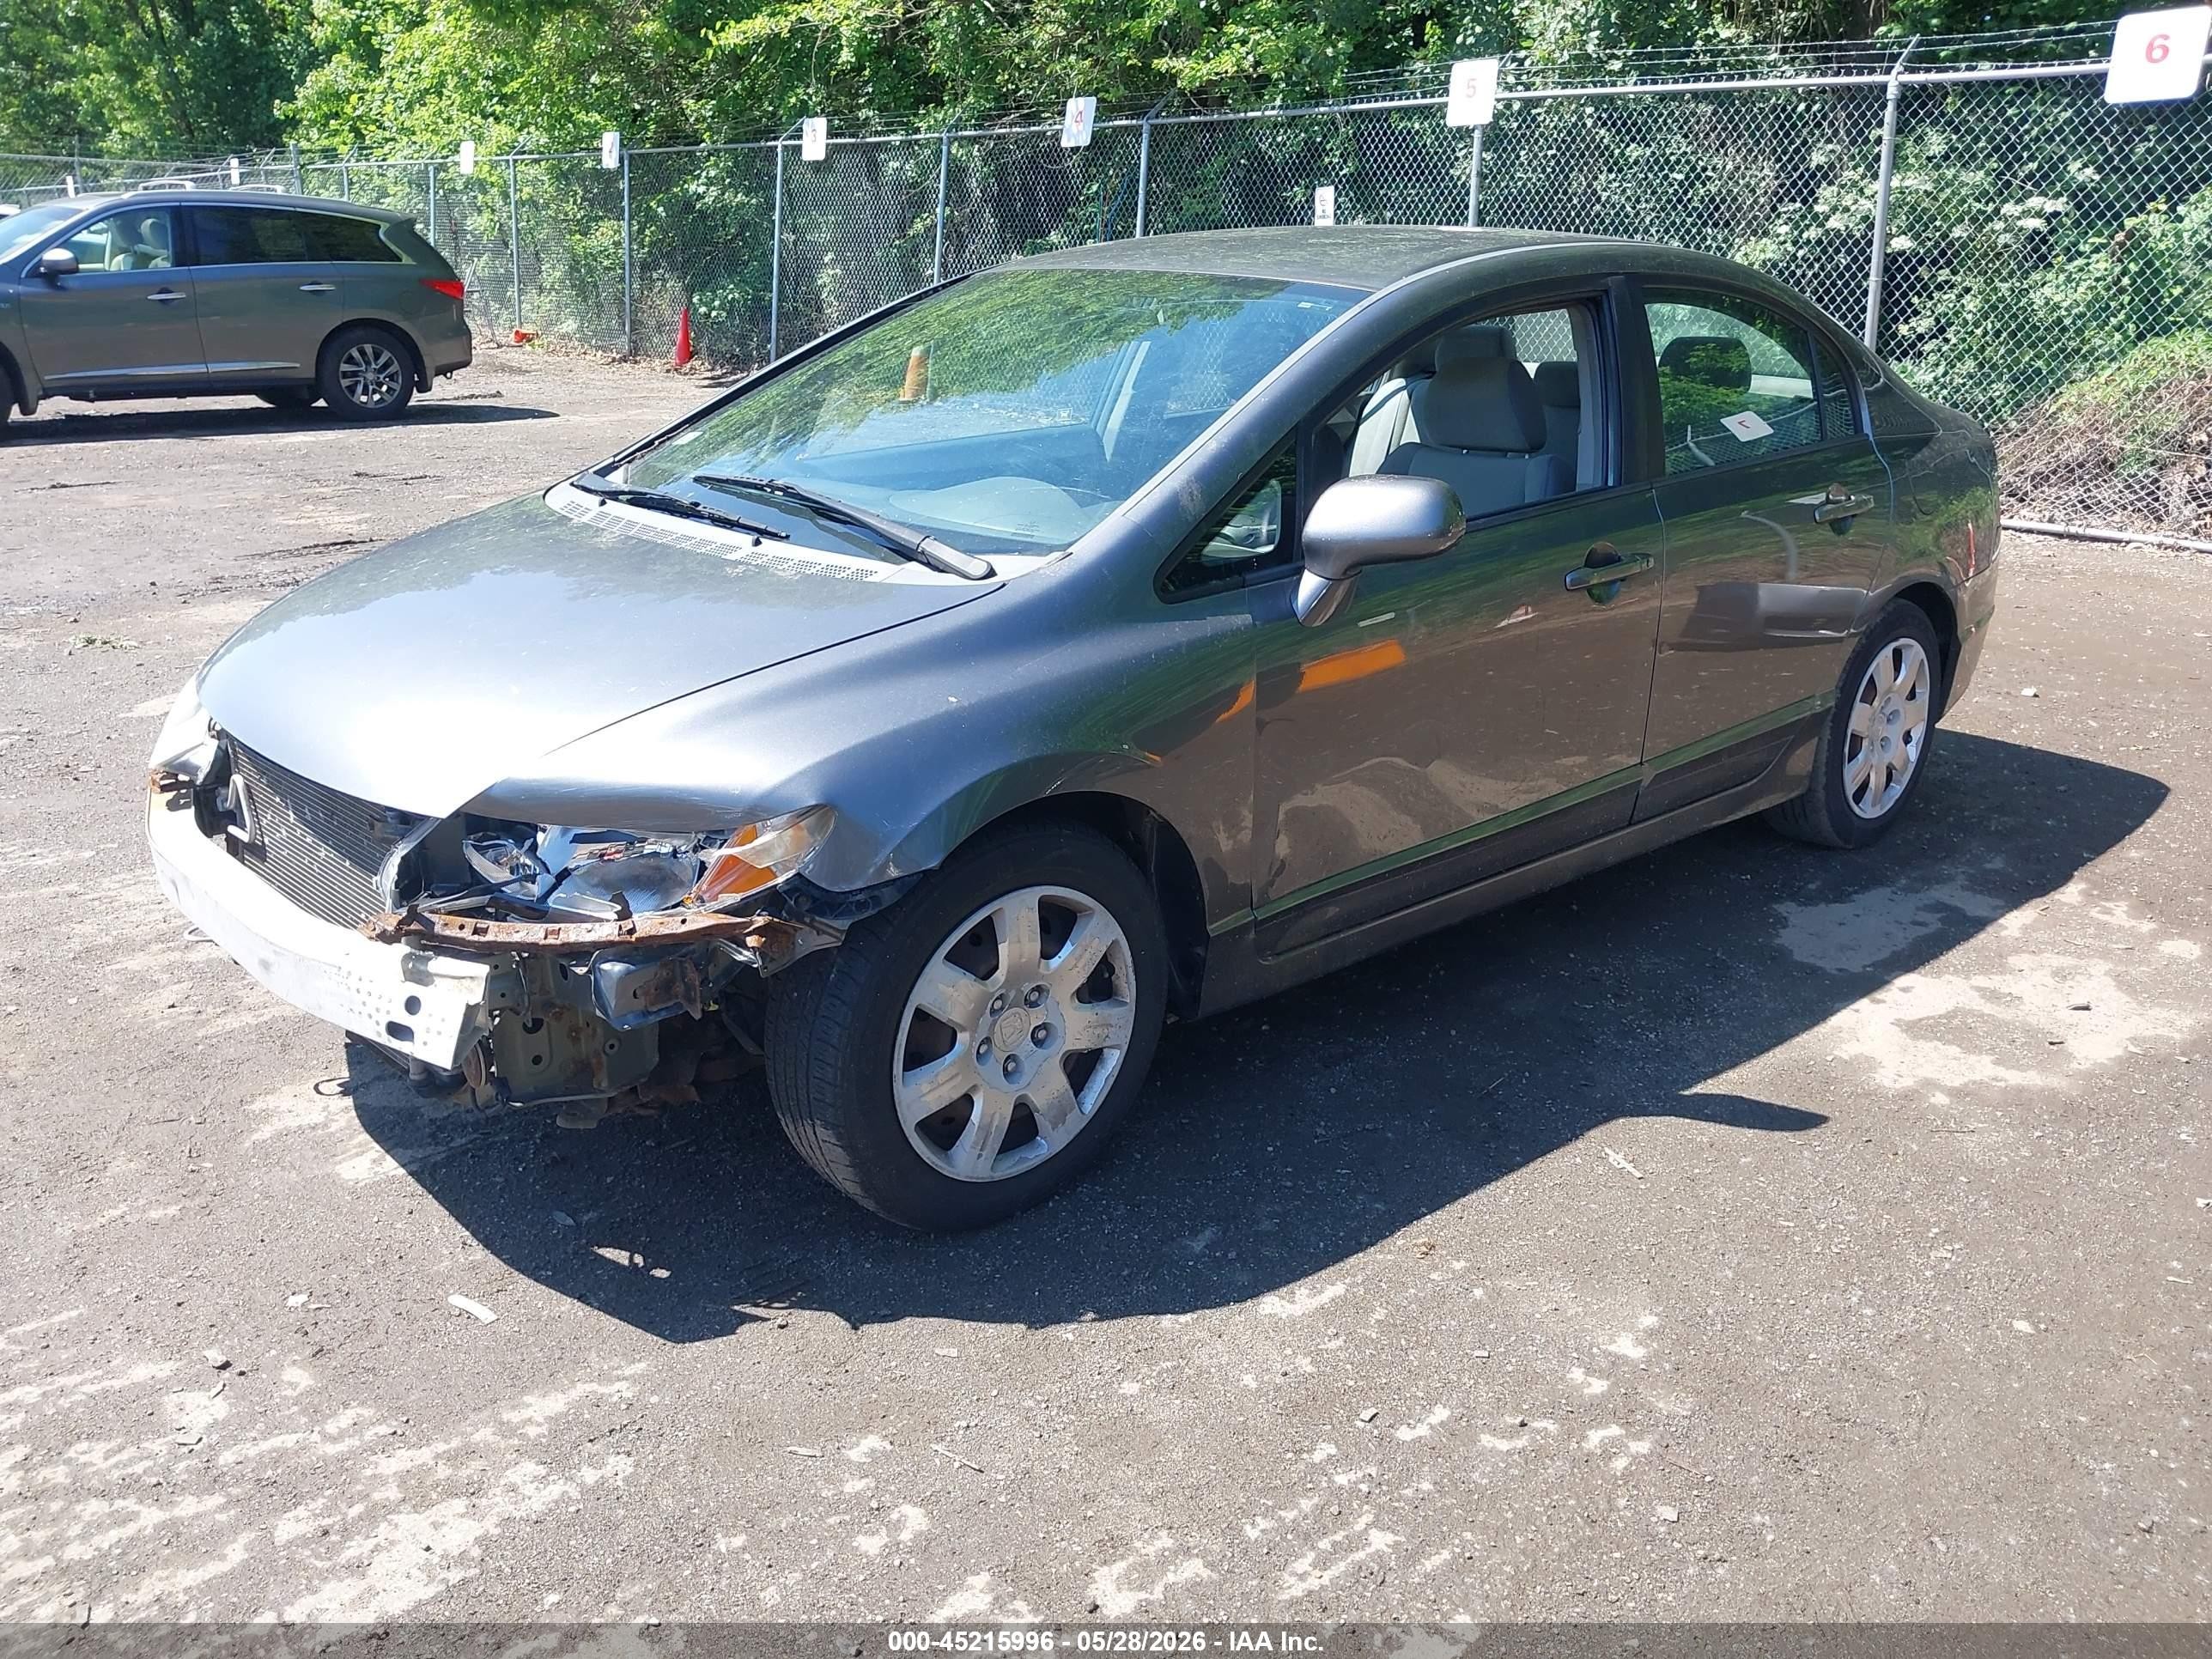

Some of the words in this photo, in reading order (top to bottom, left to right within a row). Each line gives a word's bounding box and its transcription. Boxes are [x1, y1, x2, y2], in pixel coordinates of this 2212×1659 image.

[2144, 33, 2171, 64] 6
[1466, 77, 1478, 99] 5
[1073, 110, 1085, 127] 4
